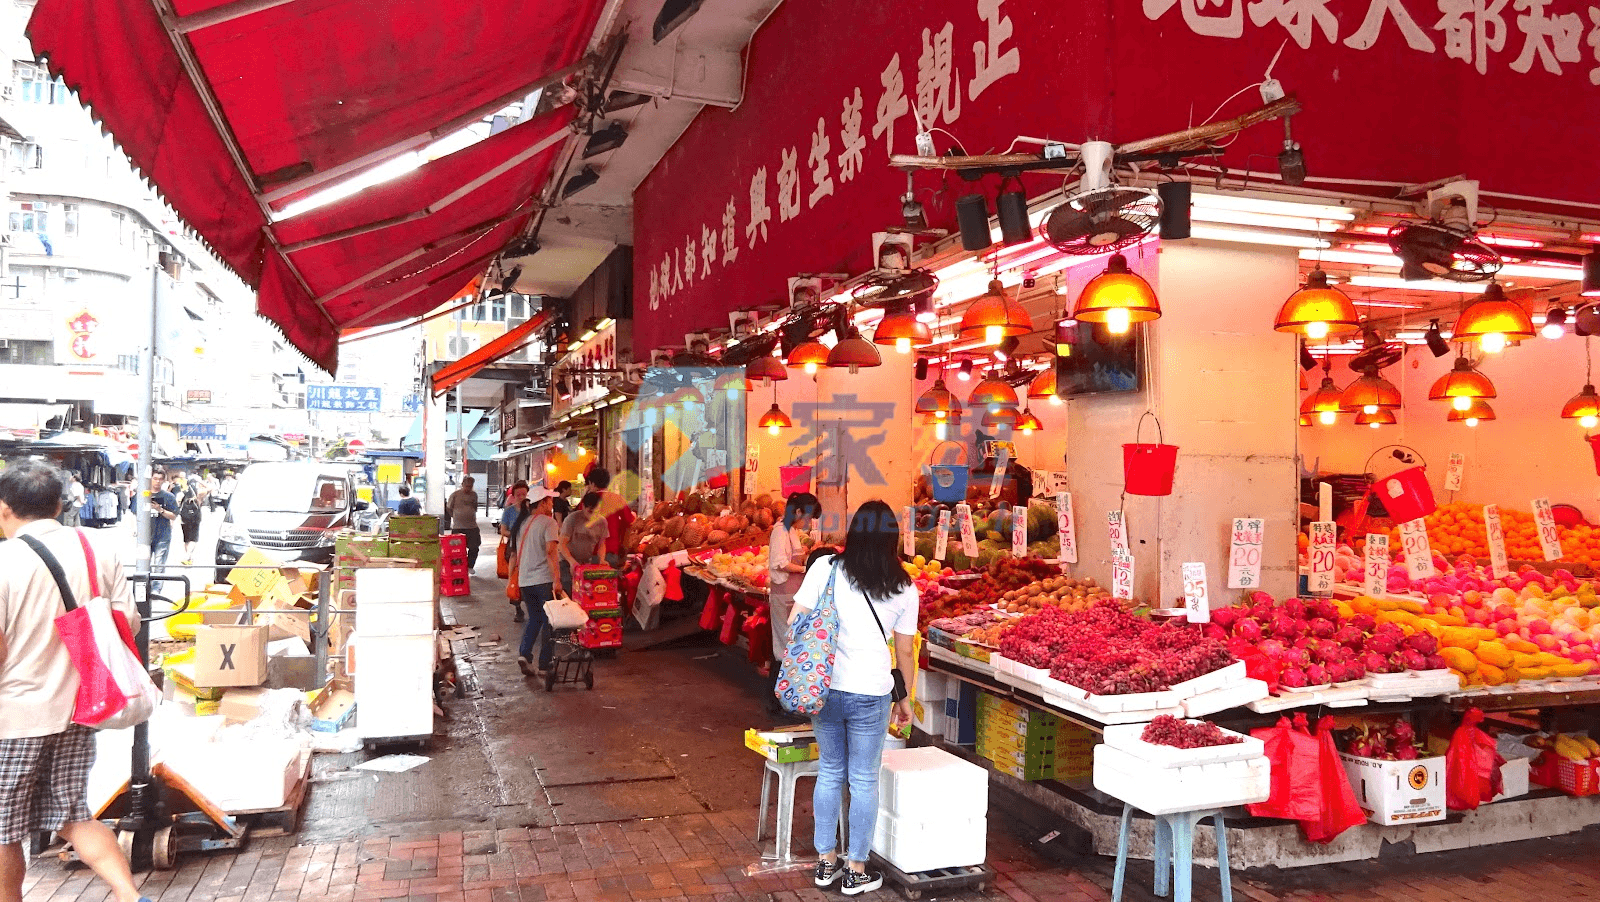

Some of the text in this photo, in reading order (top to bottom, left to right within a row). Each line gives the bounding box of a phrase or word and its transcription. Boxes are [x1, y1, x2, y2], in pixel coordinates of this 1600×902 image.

[1013, 530, 1024, 546] 30
[1542, 527, 1558, 544] 20
[1405, 536, 1428, 555] 20
[1234, 547, 1260, 567] 20
[1313, 550, 1335, 573] 20
[1368, 562, 1386, 580] 35
[219, 643, 236, 671] X
